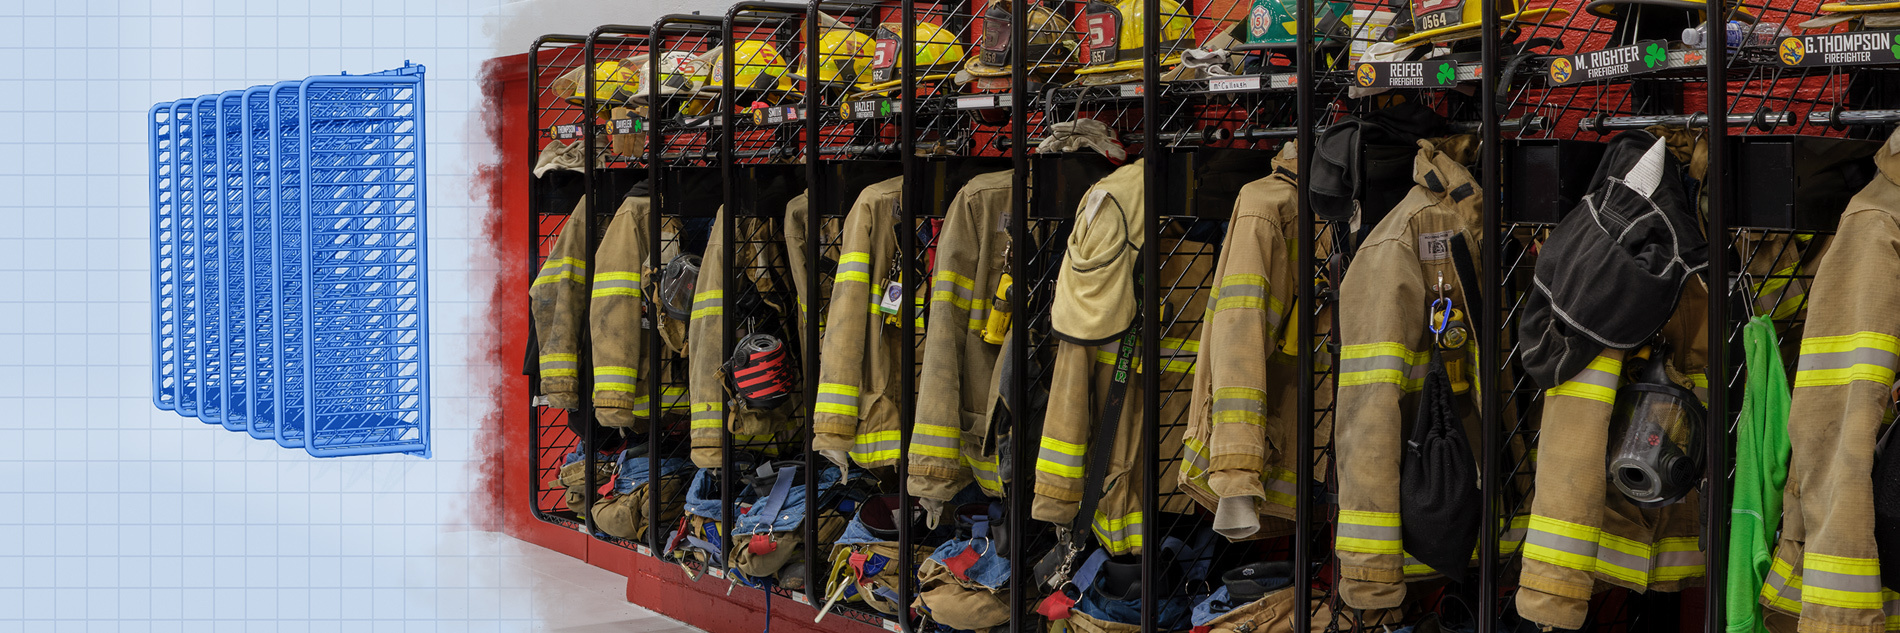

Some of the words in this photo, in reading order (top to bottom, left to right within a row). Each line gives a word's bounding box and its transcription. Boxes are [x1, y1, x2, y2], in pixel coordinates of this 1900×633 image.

[1255, 17, 1261, 27] 5
[1422, 12, 1447, 30] 0564
[985, 20, 1000, 47] 5
[1088, 18, 1104, 45] 5
[1804, 32, 1890, 53] G.THOMPSON
[874, 42, 886, 66] 5
[1574, 55, 1589, 71] M.
[1591, 45, 1640, 67] RIGHTER
[1824, 51, 1871, 63] FIREFIGHTER
[1390, 62, 1423, 77] REIFER
[1588, 63, 1629, 78] FIREFIGHTER
[1389, 77, 1424, 86] FIREFIGHTER
[854, 100, 876, 112] HAZLETT
